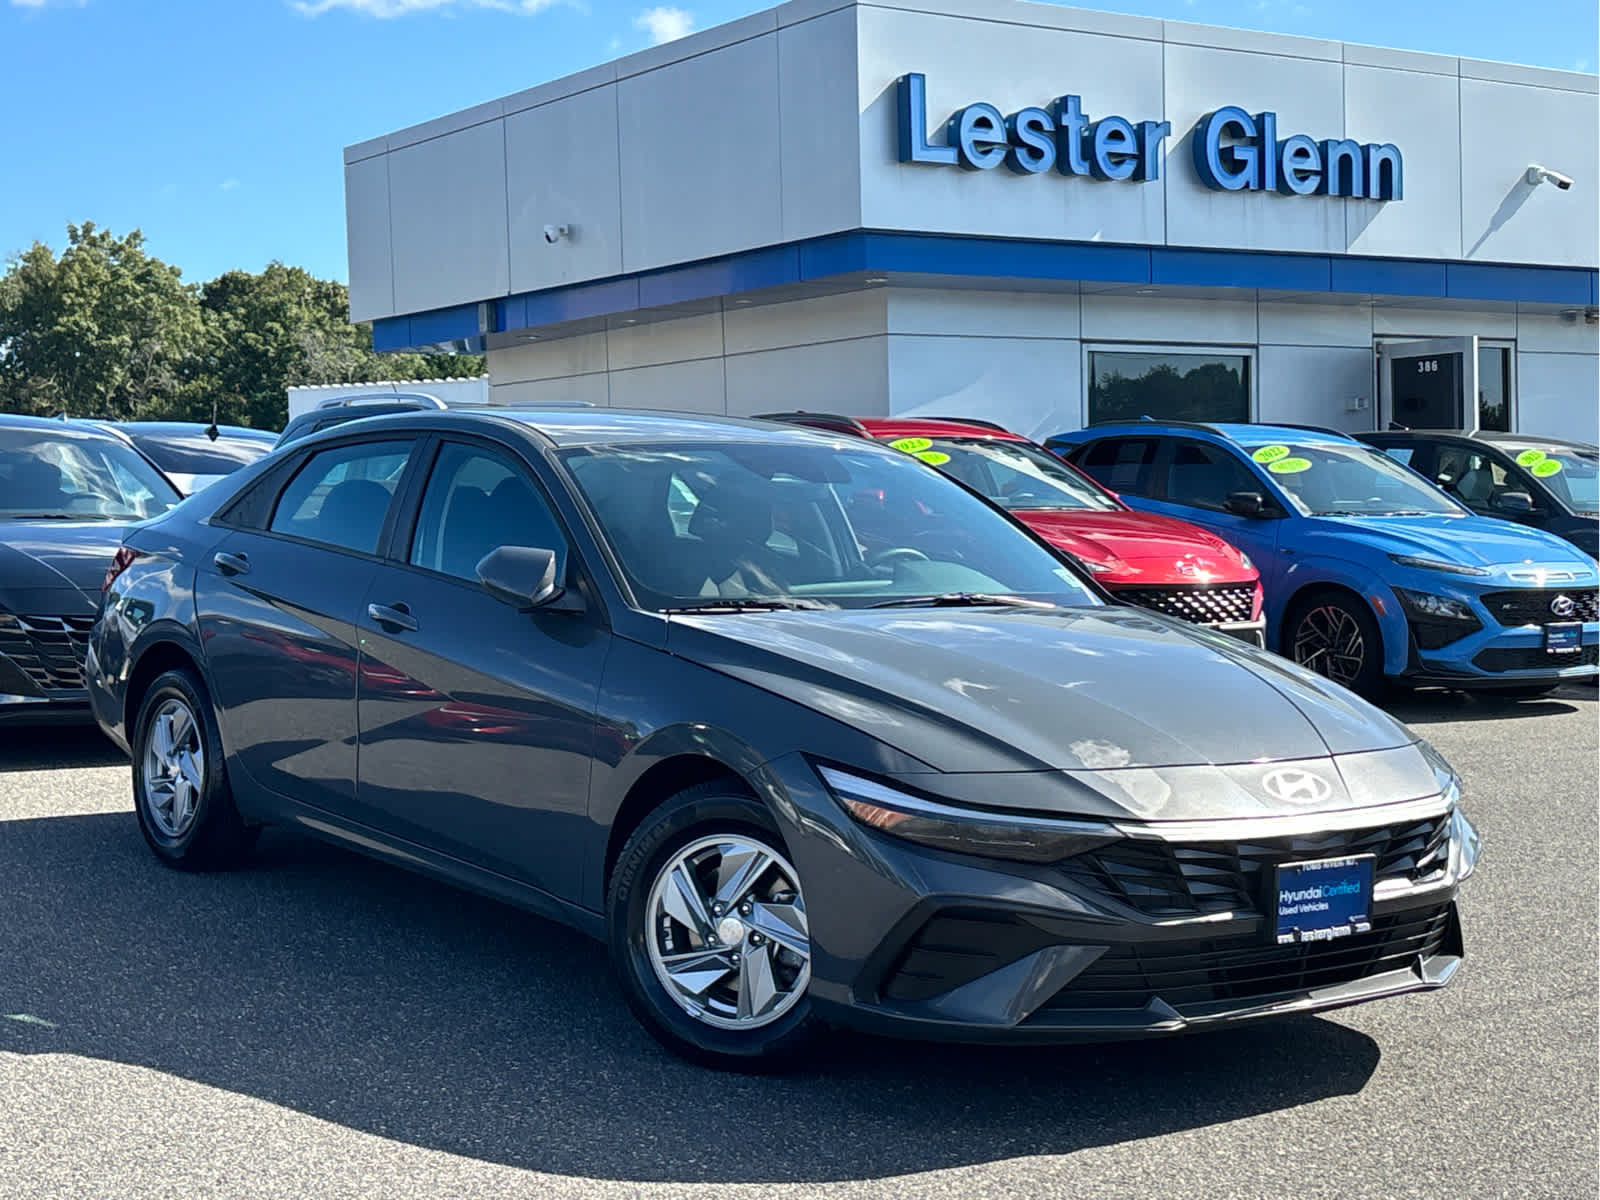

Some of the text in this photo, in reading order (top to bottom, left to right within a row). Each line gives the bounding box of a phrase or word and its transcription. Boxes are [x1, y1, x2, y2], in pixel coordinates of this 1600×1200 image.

[899, 72, 1404, 201] Lester Glenn
[1257, 446, 1284, 462] 2022
[1278, 902, 1329, 916] Used Vehicles
